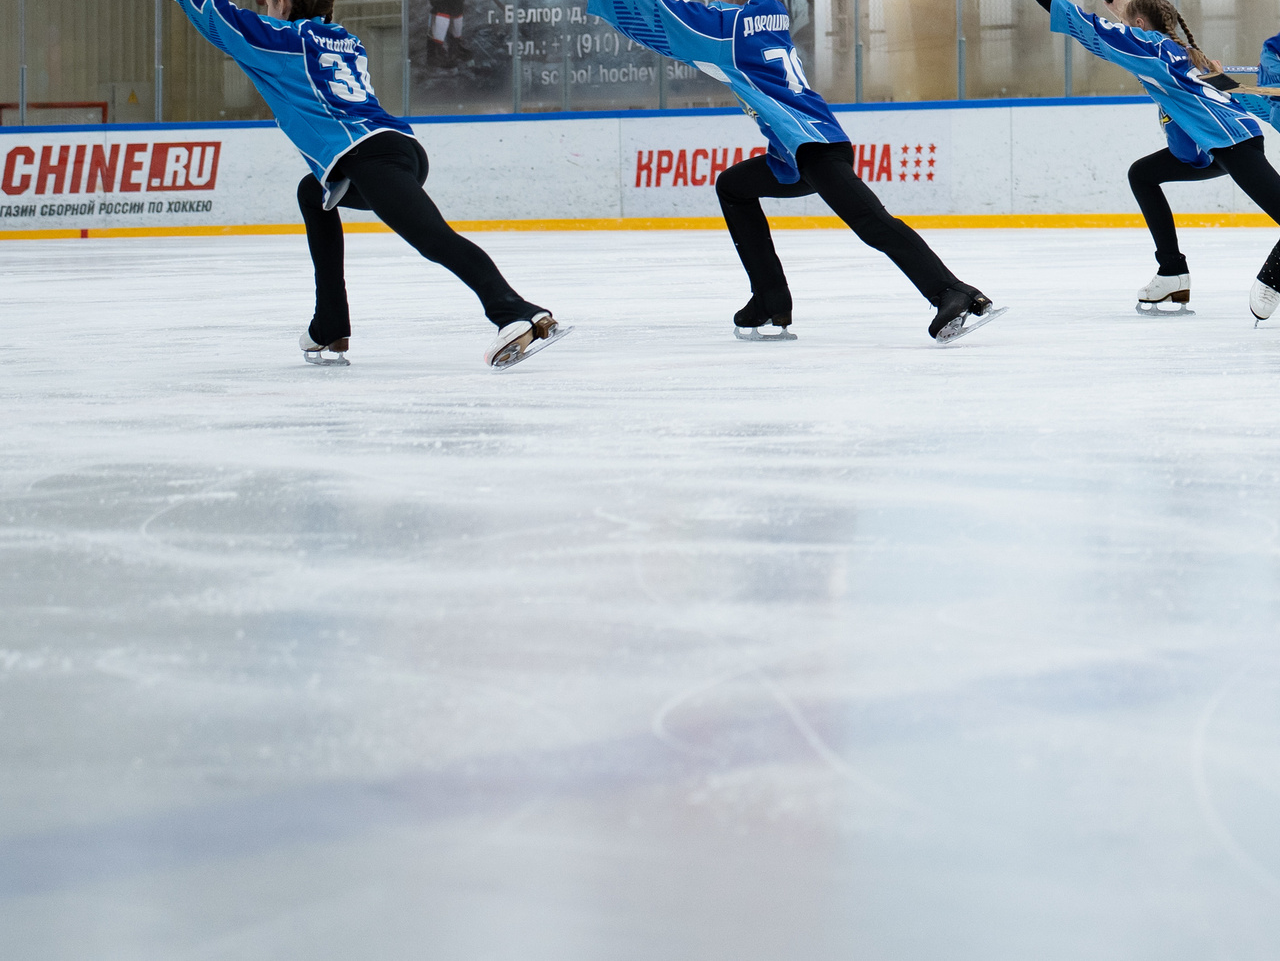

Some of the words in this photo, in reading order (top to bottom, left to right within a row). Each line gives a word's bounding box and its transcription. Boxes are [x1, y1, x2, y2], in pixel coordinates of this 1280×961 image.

[504, 4, 588, 27] Белгорд,
[40, 200, 95, 217] СБОРНОЙ
[98, 201, 145, 215] РОССИИ
[147, 201, 164, 215] ПО
[166, 199, 213, 214] ХОККЕЮ
